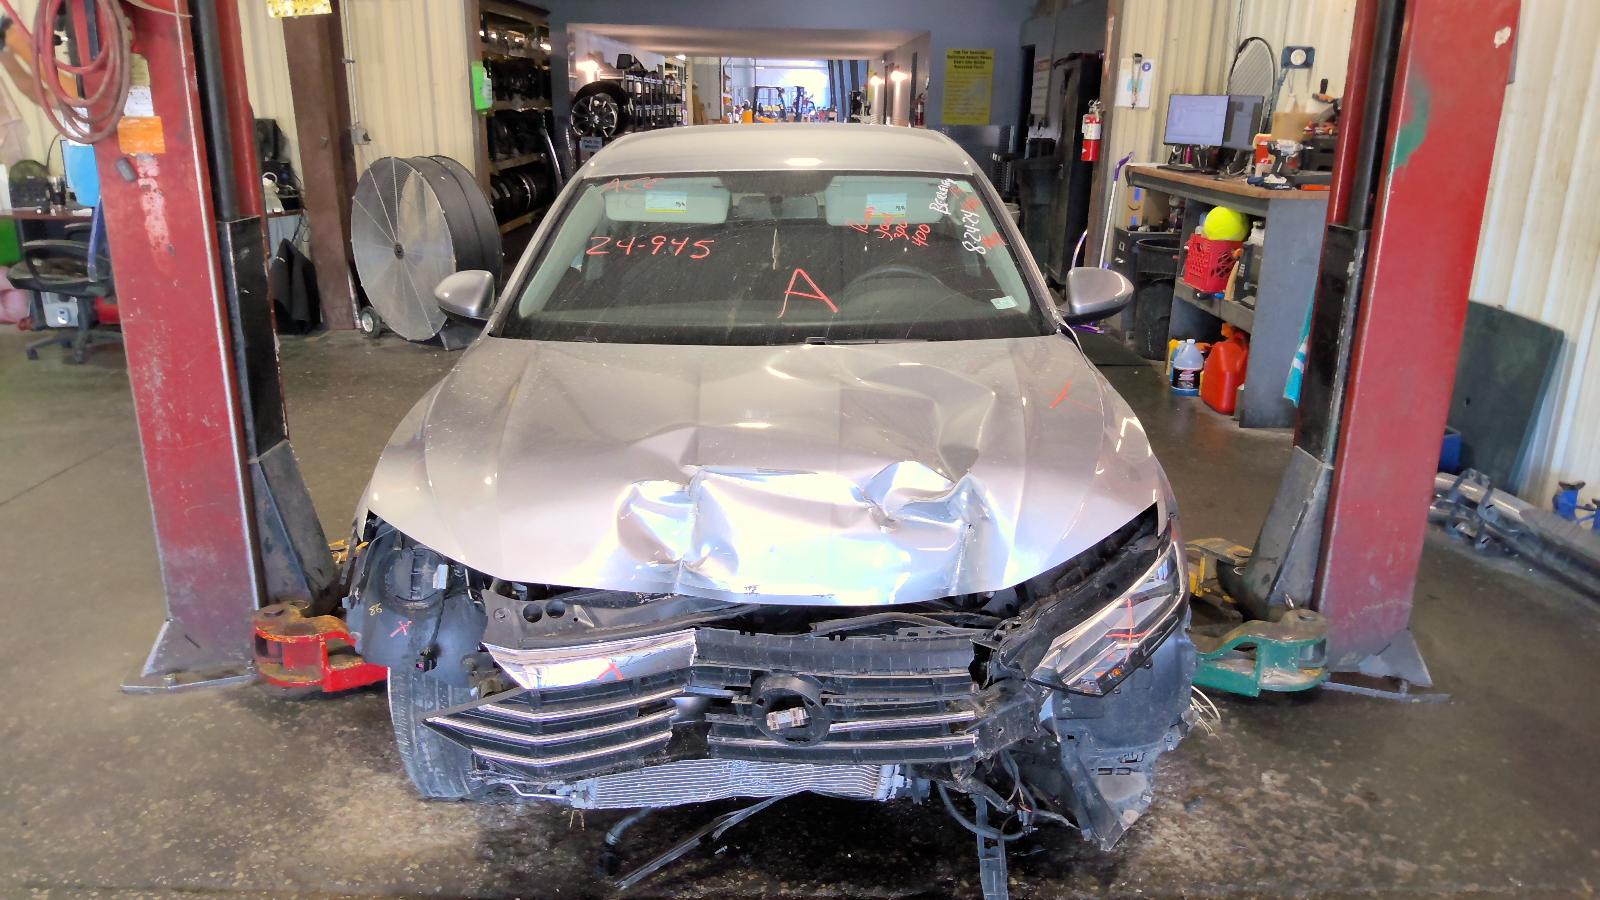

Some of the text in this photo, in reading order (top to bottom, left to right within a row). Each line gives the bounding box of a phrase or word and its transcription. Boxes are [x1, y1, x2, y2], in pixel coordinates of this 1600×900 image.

[586, 235, 715, 259] 24-945
[911, 223, 931, 247] 400
[776, 267, 839, 319] A
